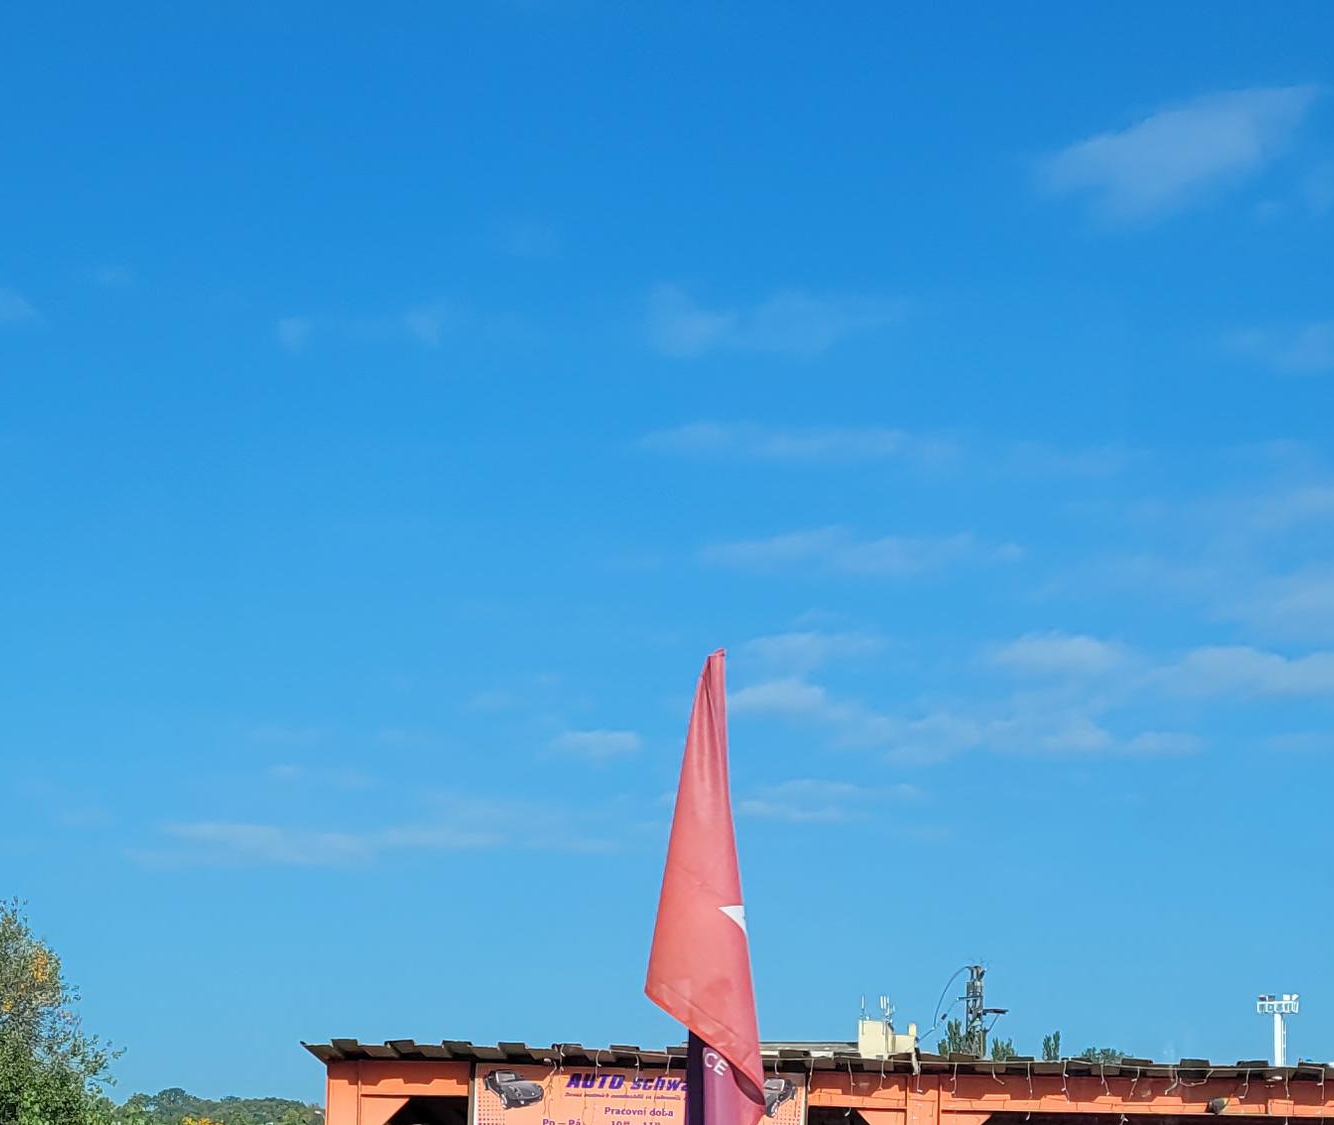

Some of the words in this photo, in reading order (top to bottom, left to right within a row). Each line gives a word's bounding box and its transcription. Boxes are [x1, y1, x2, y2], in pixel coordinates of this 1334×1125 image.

[566, 1073, 625, 1090] AUTO
[630, 1076, 688, 1092] schwa
[604, 1106, 647, 1116] Pracovní
